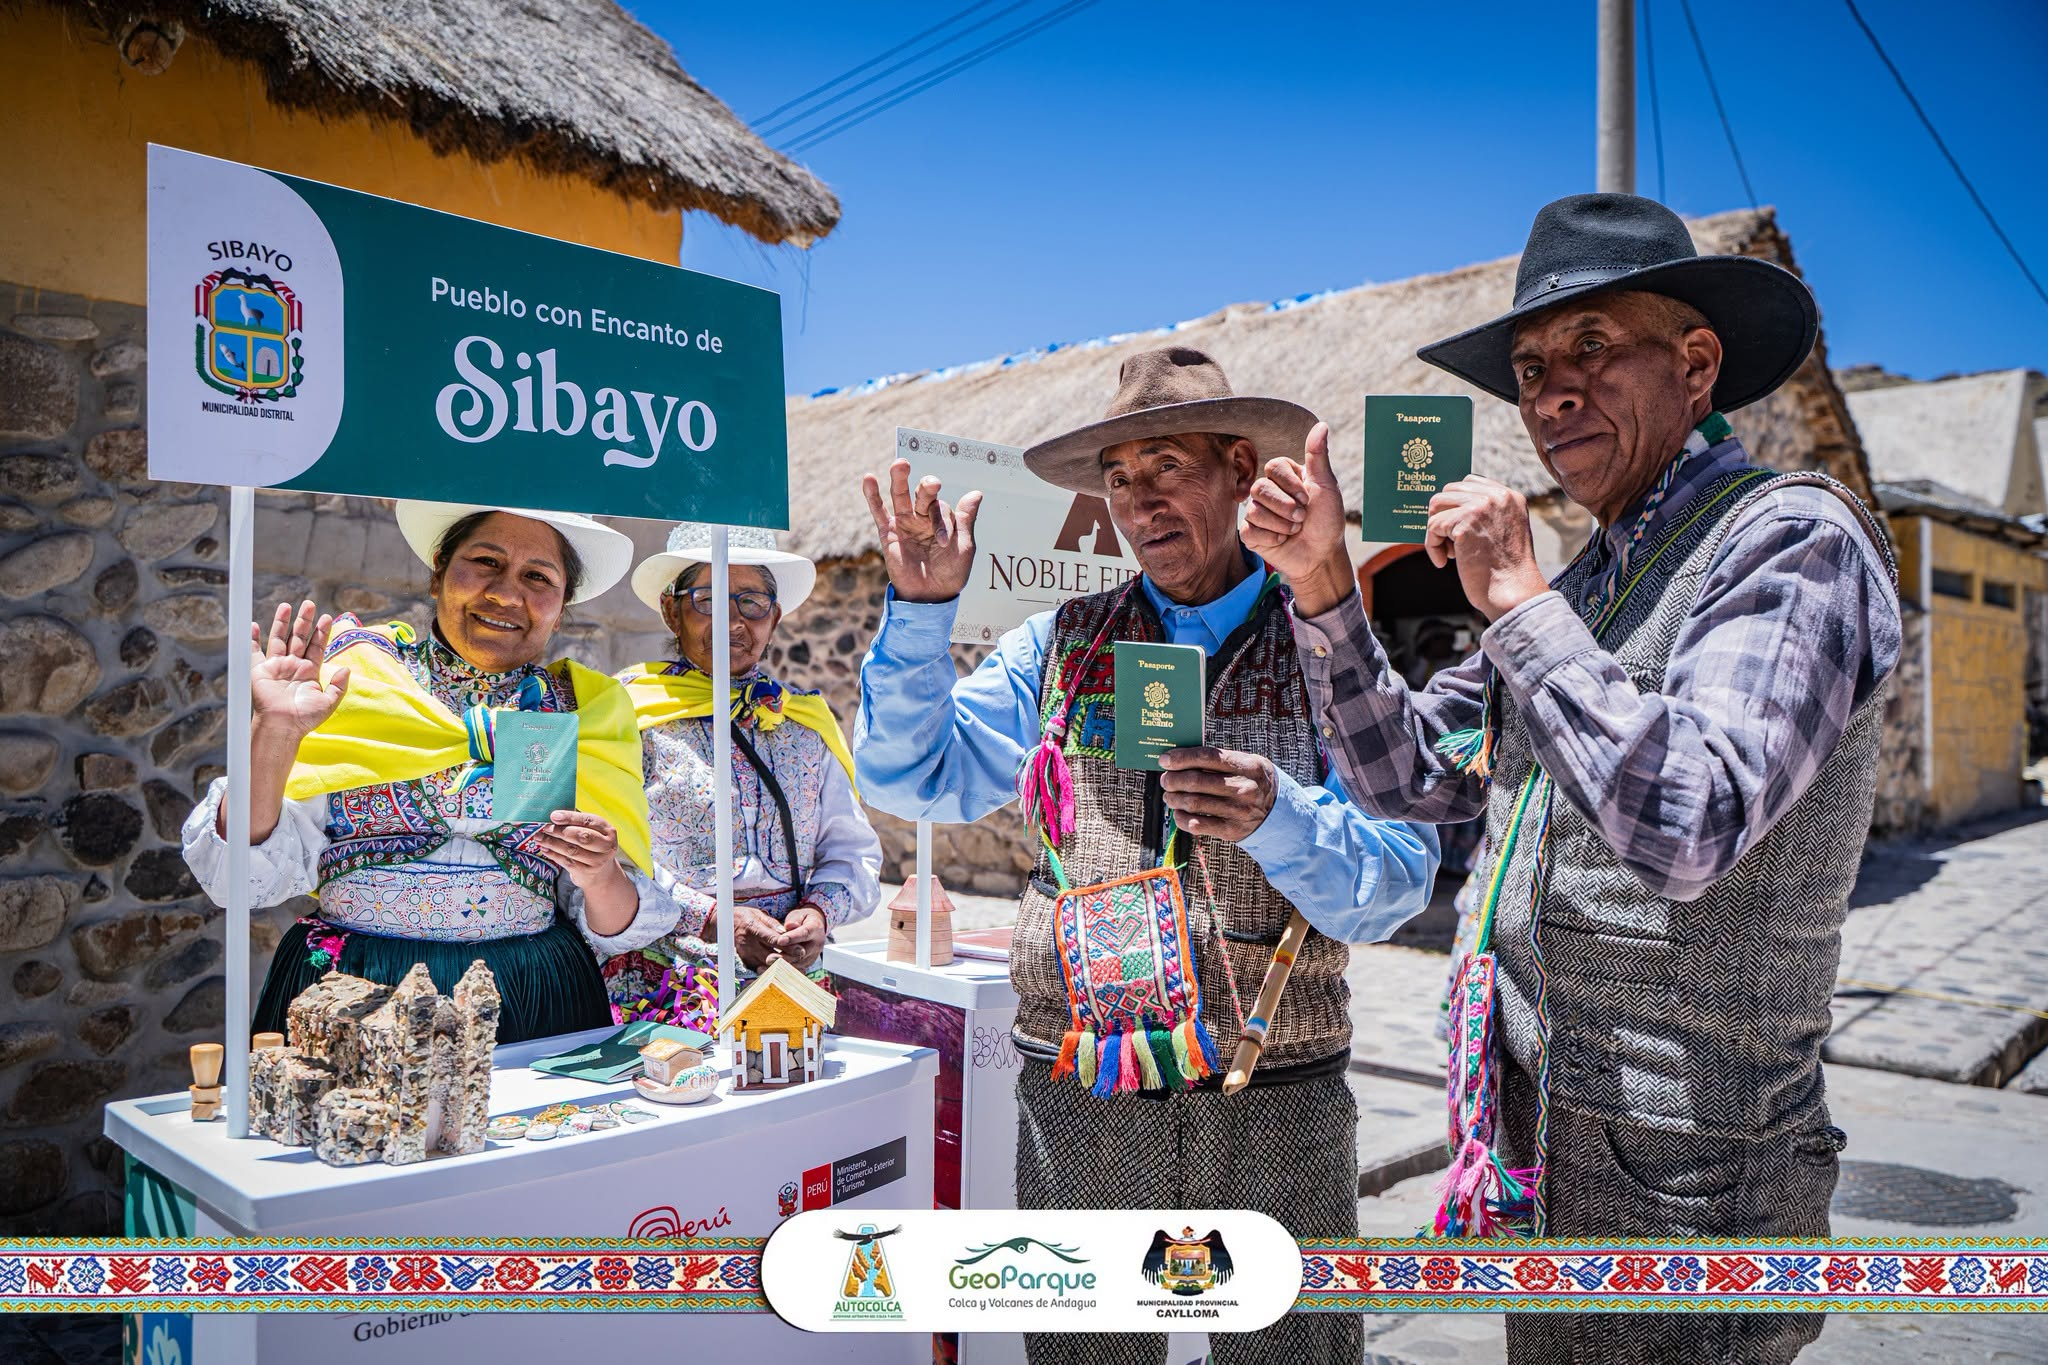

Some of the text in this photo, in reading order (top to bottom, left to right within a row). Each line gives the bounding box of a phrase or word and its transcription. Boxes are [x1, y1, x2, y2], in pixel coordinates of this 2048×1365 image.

[207, 240, 293, 272] SIBAYO
[431, 277, 723, 354] Pueblo con Encanto de
[202, 401, 295, 421] MUNICIPALIDAD DISTRITAL
[434, 335, 718, 469] Sibayo
[1396, 413, 1441, 424] Pasaporte
[1397, 470, 1436, 482] Pueblos
[1397, 480, 1436, 492] Encanto
[989, 553, 1090, 592] NOBLE
[1138, 660, 1175, 670] Pasaporte
[1141, 708, 1174, 719] Pueblos
[1141, 717, 1174, 728] Encanto
[837, 1159, 867, 1177] Ministerio
[837, 1158, 895, 1186] de Comercio Exterior
[807, 1178, 828, 1198] PERÚ
[836, 1179, 865, 1197] y Turismo
